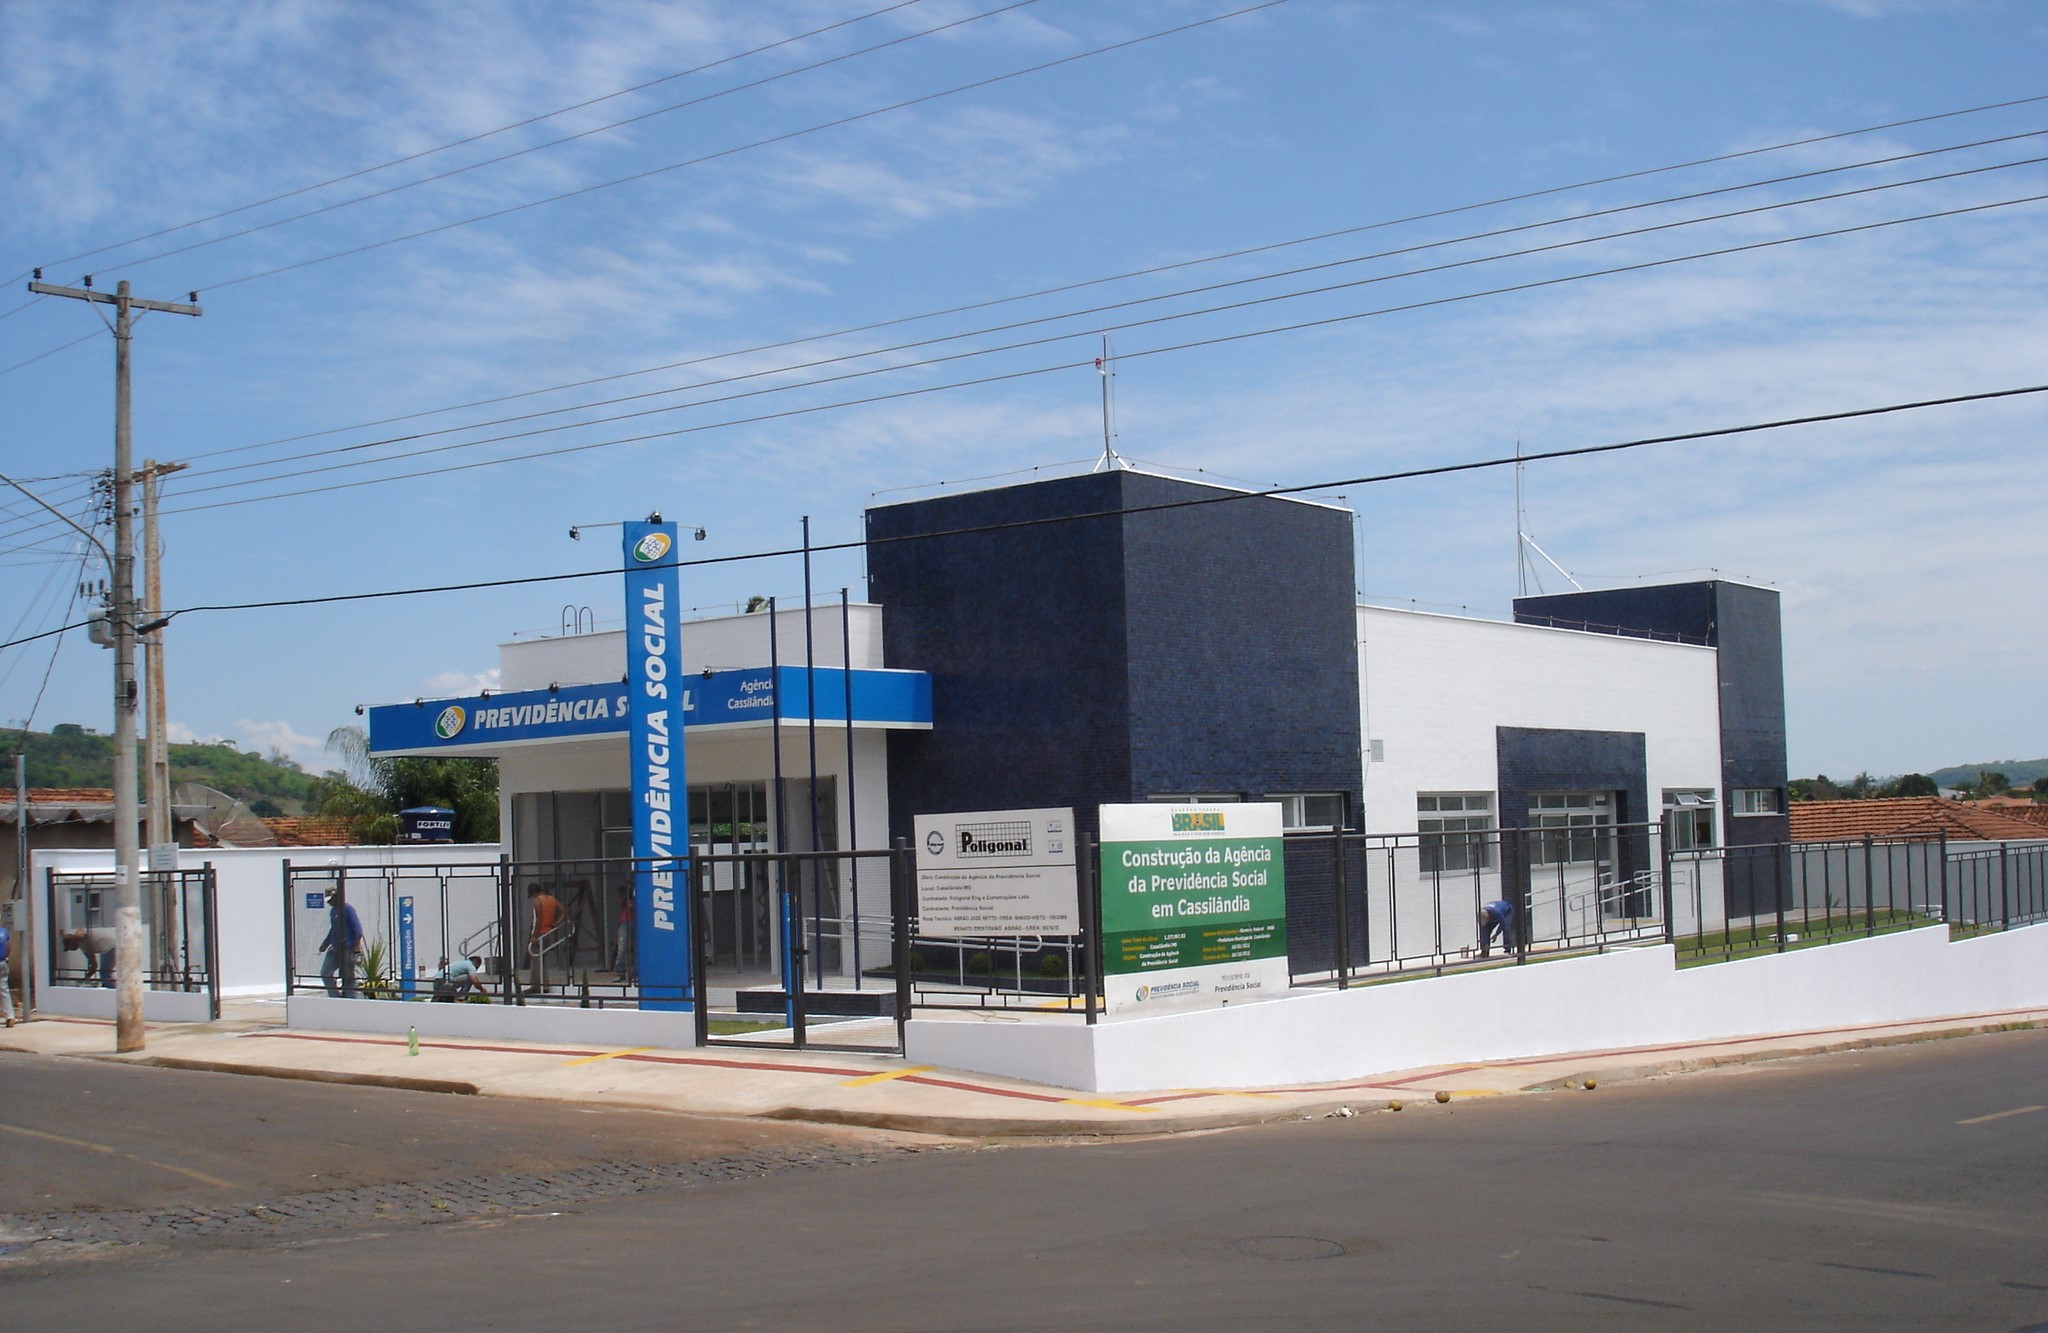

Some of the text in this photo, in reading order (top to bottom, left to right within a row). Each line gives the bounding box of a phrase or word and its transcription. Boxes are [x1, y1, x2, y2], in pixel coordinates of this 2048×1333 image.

[740, 679, 773, 694] Agênci
[474, 697, 609, 730] PREVIDÊNCIA
[728, 695, 774, 709] Cassilândi
[643, 582, 675, 931] PREVIDÊNCIA SOCIAL
[1172, 813, 1225, 831] BRASIL
[961, 831, 1027, 854] Poligonal
[1122, 845, 1271, 869] Construção da Agência
[1128, 870, 1267, 893] da Previdência Social
[1152, 895, 1250, 918] em Cassilândia
[405, 929, 413, 970] Recepção
[1214, 981, 1261, 993] Previdência Social
